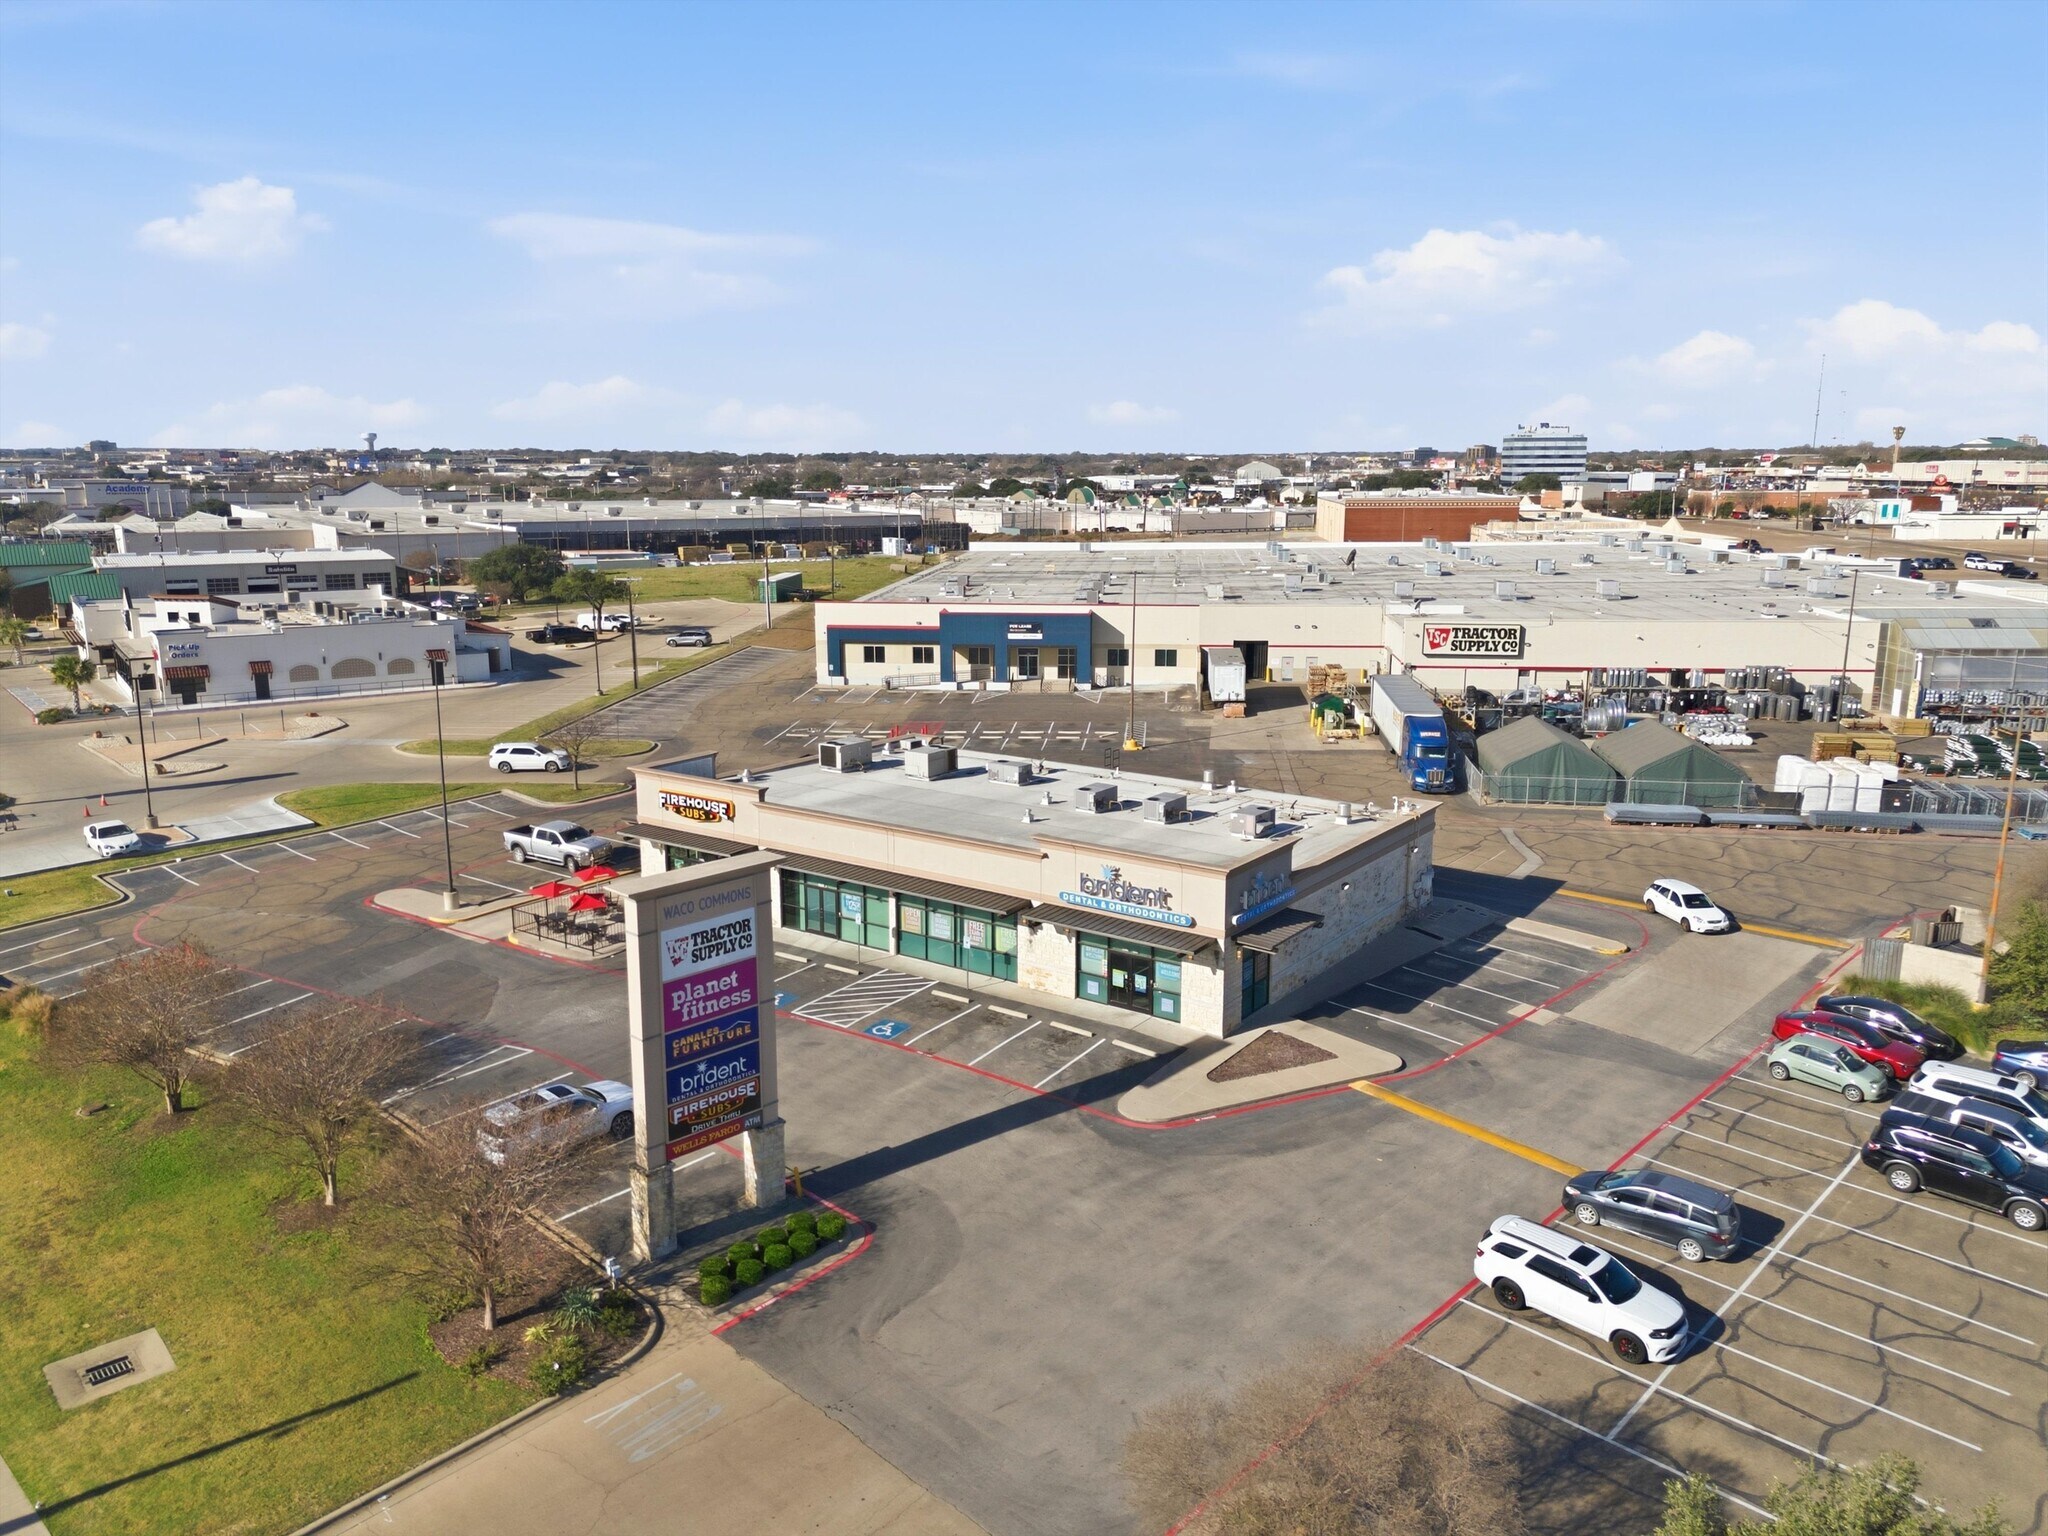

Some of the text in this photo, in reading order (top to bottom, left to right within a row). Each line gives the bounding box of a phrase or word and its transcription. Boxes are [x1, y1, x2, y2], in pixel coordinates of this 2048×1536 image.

[105, 484, 150, 493] Academy
[1428, 628, 1446, 646] TSC
[1450, 640, 1500, 652] SUPPLY
[1452, 628, 1518, 640] TRACTOR
[658, 792, 728, 820] FIREHOUSE
[680, 806, 706, 820] SUBS
[664, 887, 751, 920] WACO COMMONS
[1062, 893, 1098, 907] DENTAL
[1108, 902, 1186, 925] ORTHODONTICS
[691, 918, 752, 947] TRACTOR
[691, 937, 737, 964] SUPPLY
[672, 970, 738, 1011] planet
[682, 989, 751, 1022] fitness
[672, 1026, 720, 1048] CANALES
[673, 1024, 752, 1057] FURNITURE
[672, 1091, 697, 1102] DENTAL
[705, 1069, 756, 1091] ORTHODONTICS
[681, 1057, 747, 1093] brident
[674, 1081, 756, 1125] FIREHOUSE
[701, 1100, 732, 1119] SUBS
[672, 1116, 760, 1154] WELLS FARGO ATM
[692, 1119, 717, 1133] DRIVE
